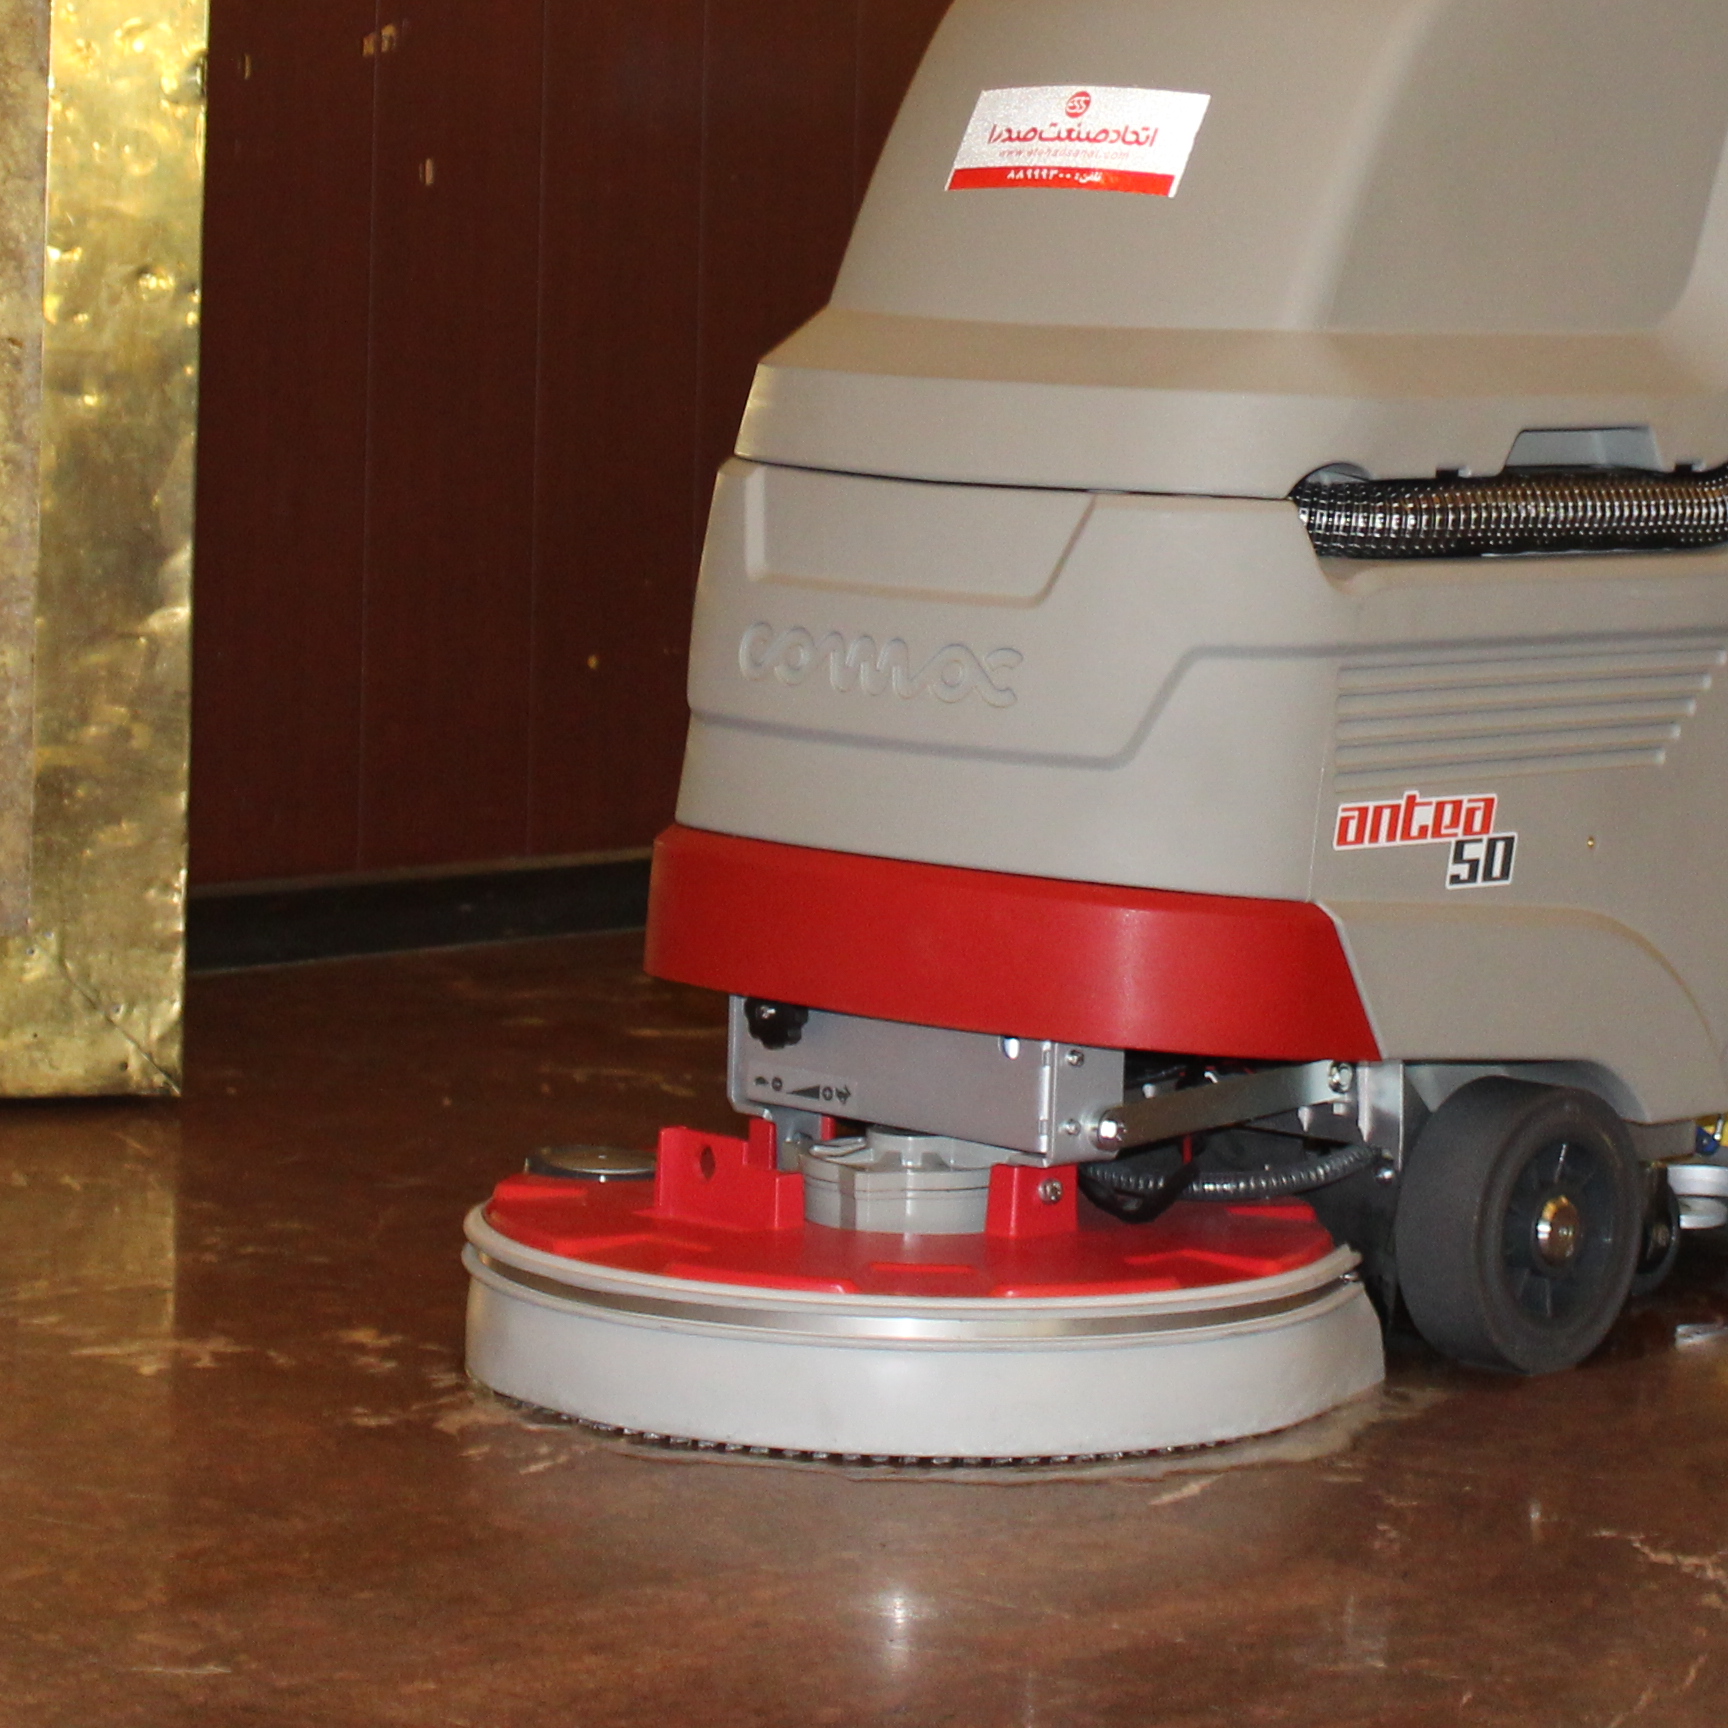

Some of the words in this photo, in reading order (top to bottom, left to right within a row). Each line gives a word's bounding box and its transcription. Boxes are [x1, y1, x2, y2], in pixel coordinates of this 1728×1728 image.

[987, 124, 1038, 145] صدرا
[1039, 122, 1110, 144] صنعت
[1109, 125, 1159, 146] اتحاد
[1336, 793, 1496, 847] antea
[1448, 835, 1516, 886] 50
